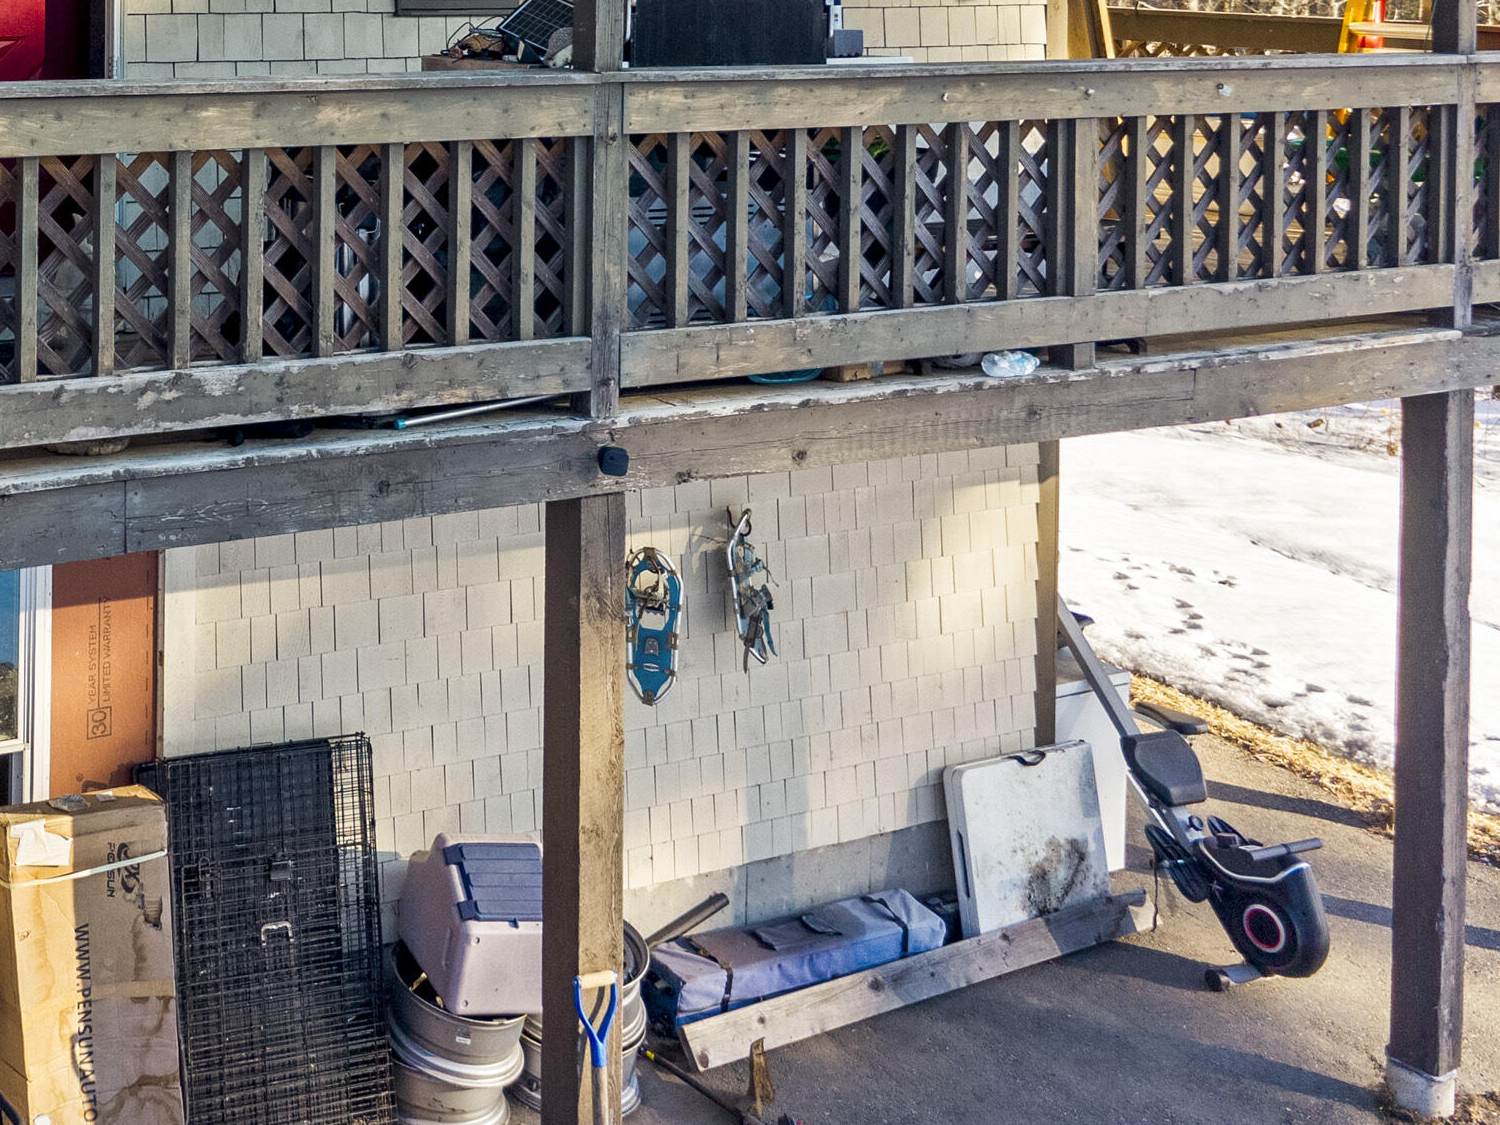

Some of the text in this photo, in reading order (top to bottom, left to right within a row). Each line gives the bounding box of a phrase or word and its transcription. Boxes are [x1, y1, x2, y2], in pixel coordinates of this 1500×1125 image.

[88, 624, 98, 705] YEAR SYSTEM
[102, 595, 113, 703] LIMITED WARRANTY
[91, 709, 108, 737] 30
[106, 842, 116, 898] PESUN
